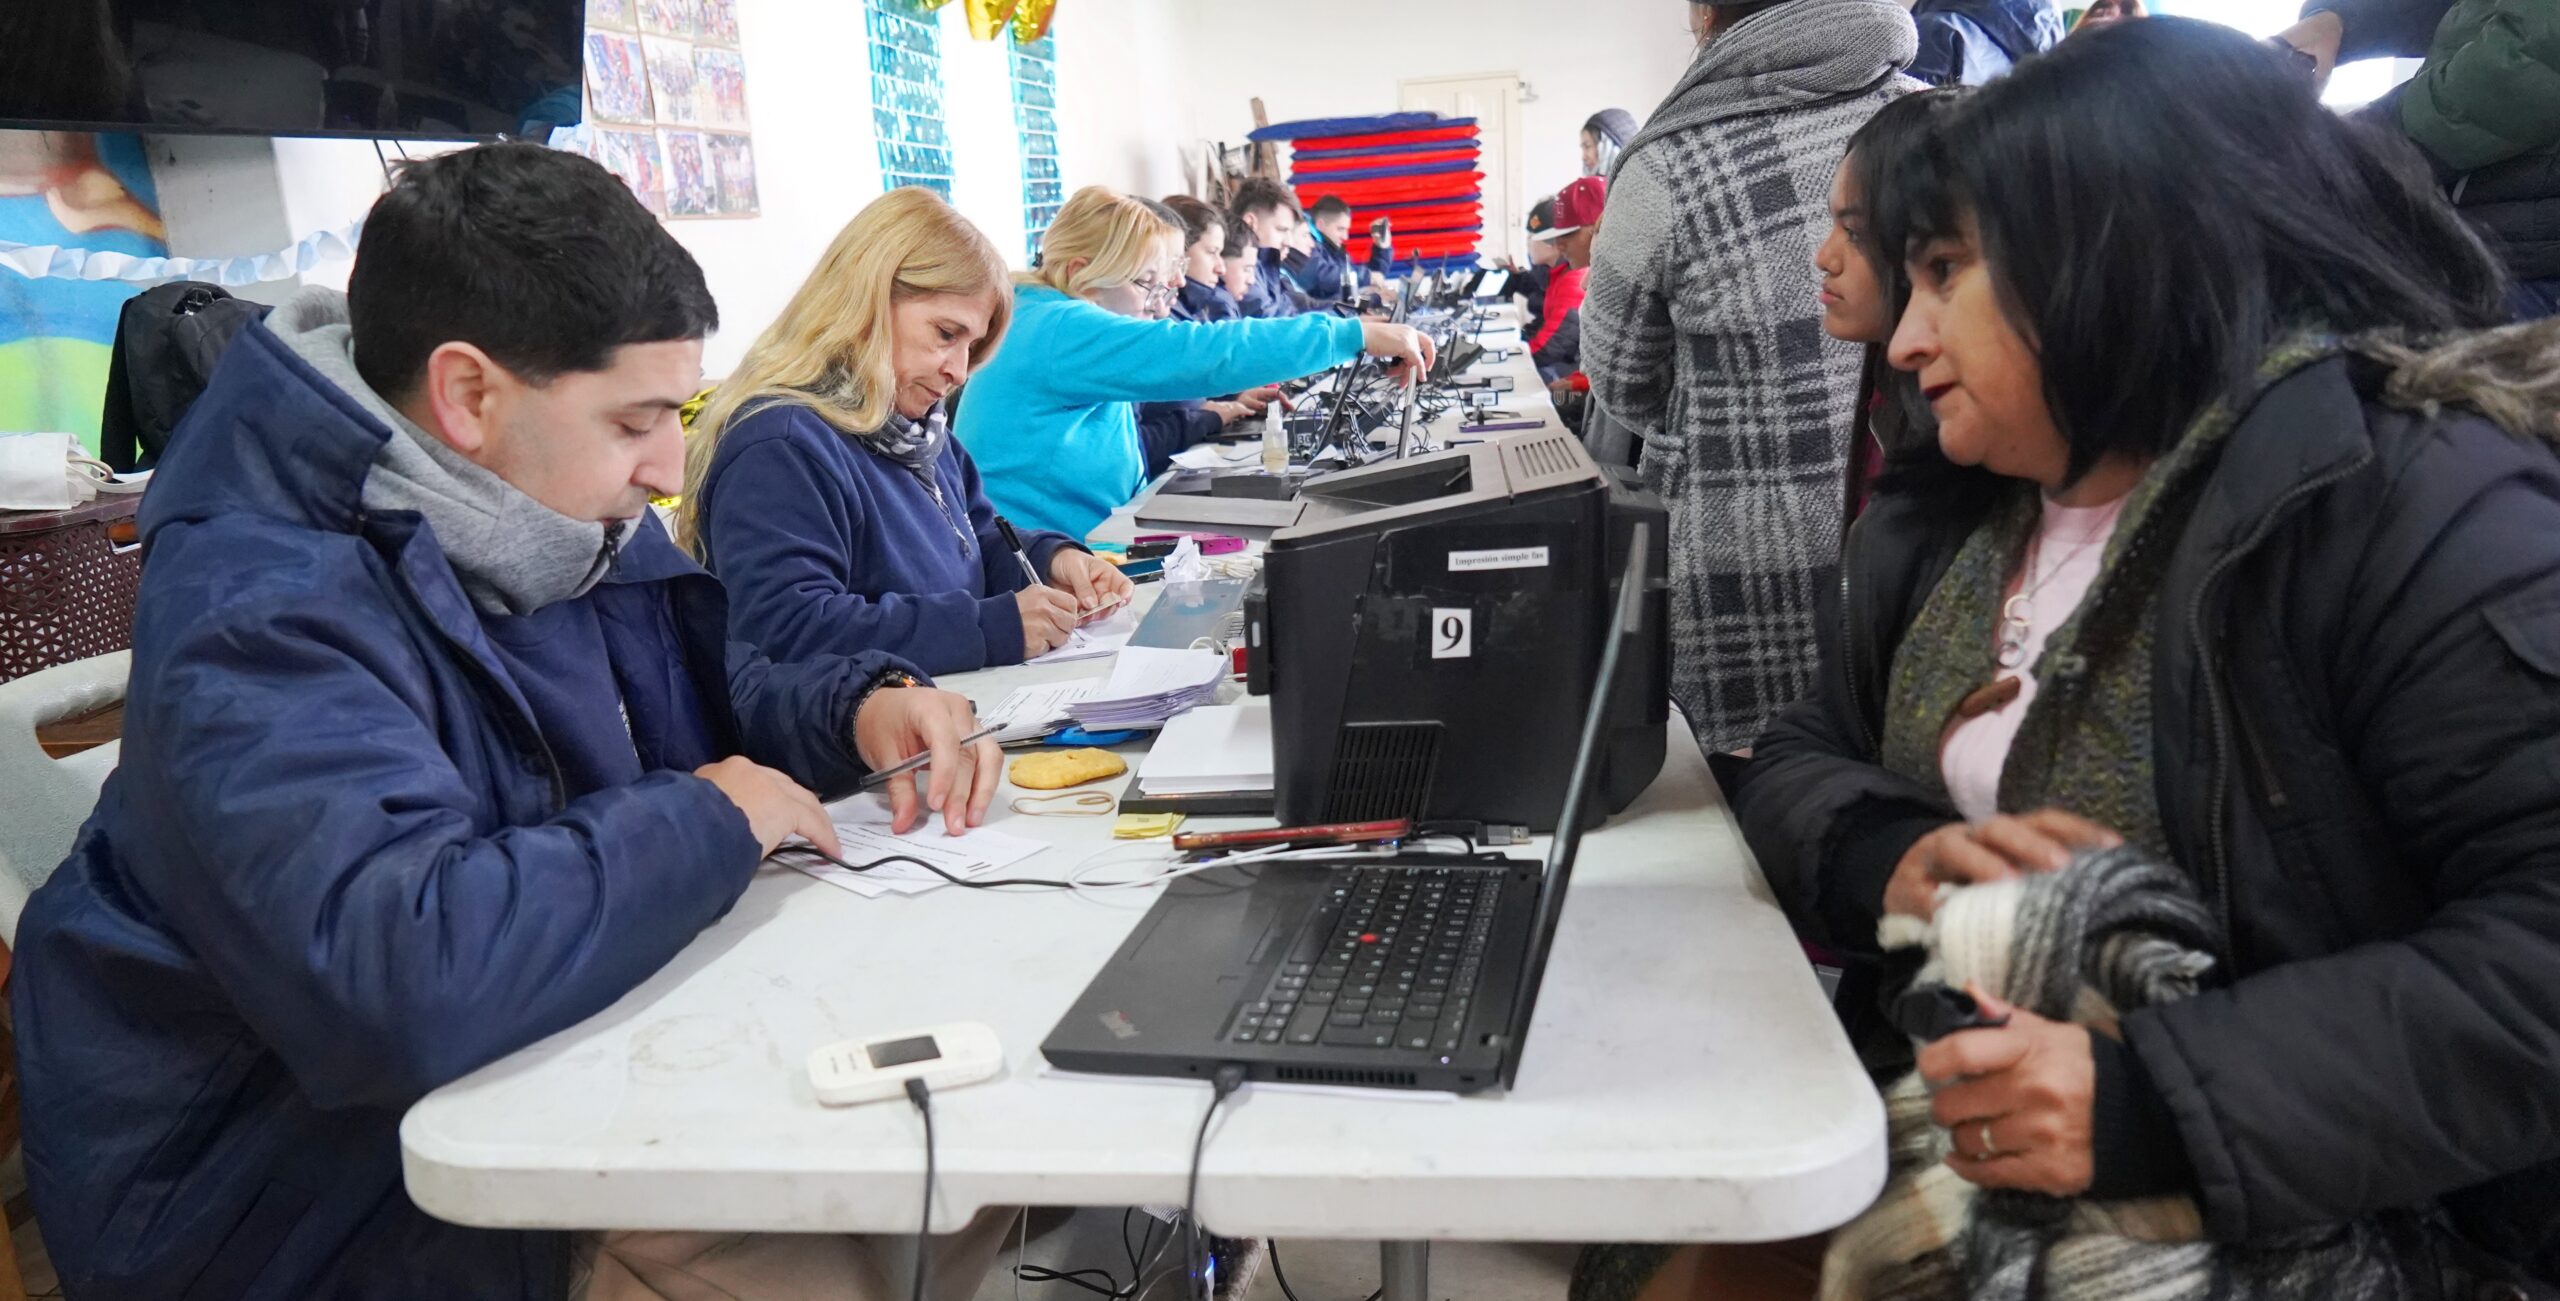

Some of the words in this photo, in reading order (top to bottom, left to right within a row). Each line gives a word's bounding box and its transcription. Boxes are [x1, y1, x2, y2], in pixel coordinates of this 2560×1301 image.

[1455, 555, 1498, 566] Impresión
[1501, 552, 1529, 563] simple
[1439, 616, 1464, 652] 9
